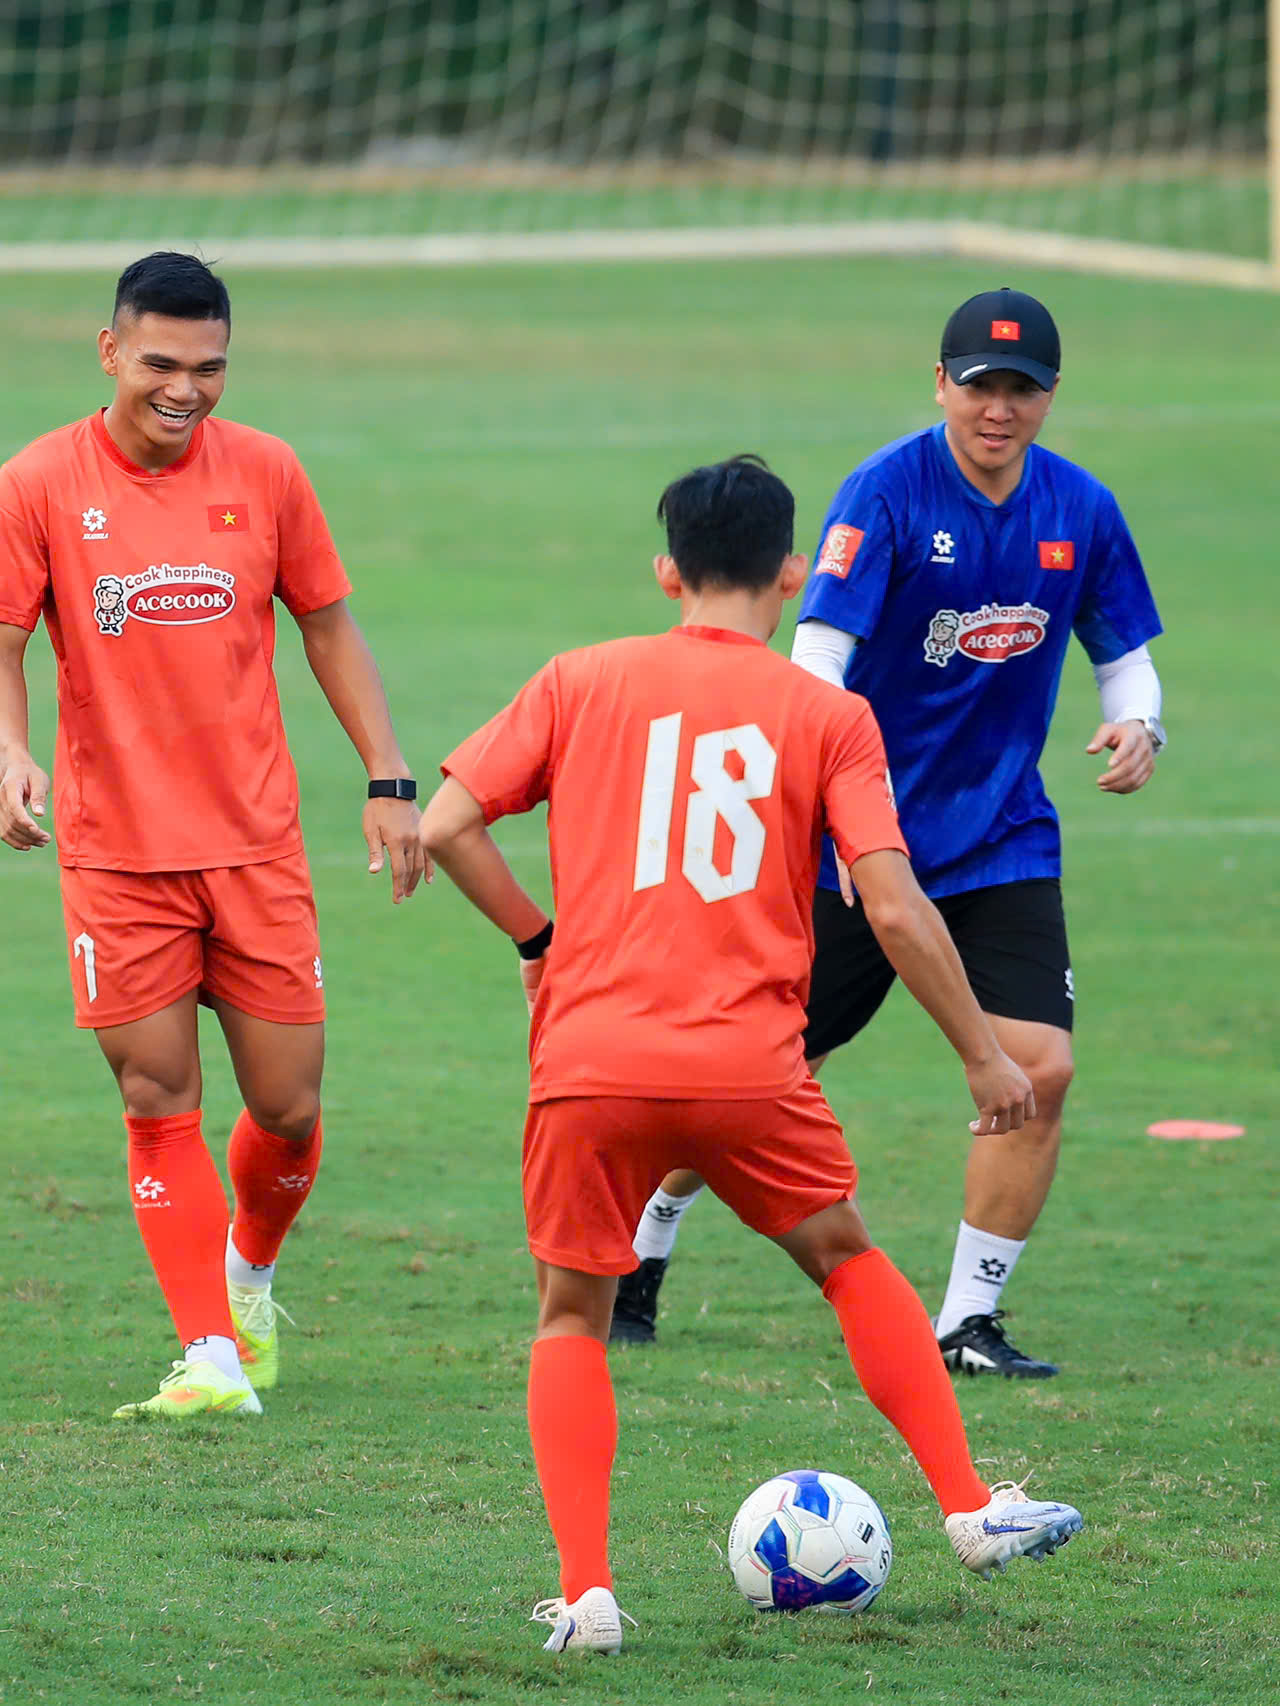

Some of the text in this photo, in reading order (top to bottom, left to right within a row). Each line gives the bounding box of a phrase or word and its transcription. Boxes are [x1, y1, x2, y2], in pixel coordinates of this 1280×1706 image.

[125, 565, 233, 589] Cook happiness
[962, 607, 991, 626] Cook
[633, 711, 777, 904] 18
